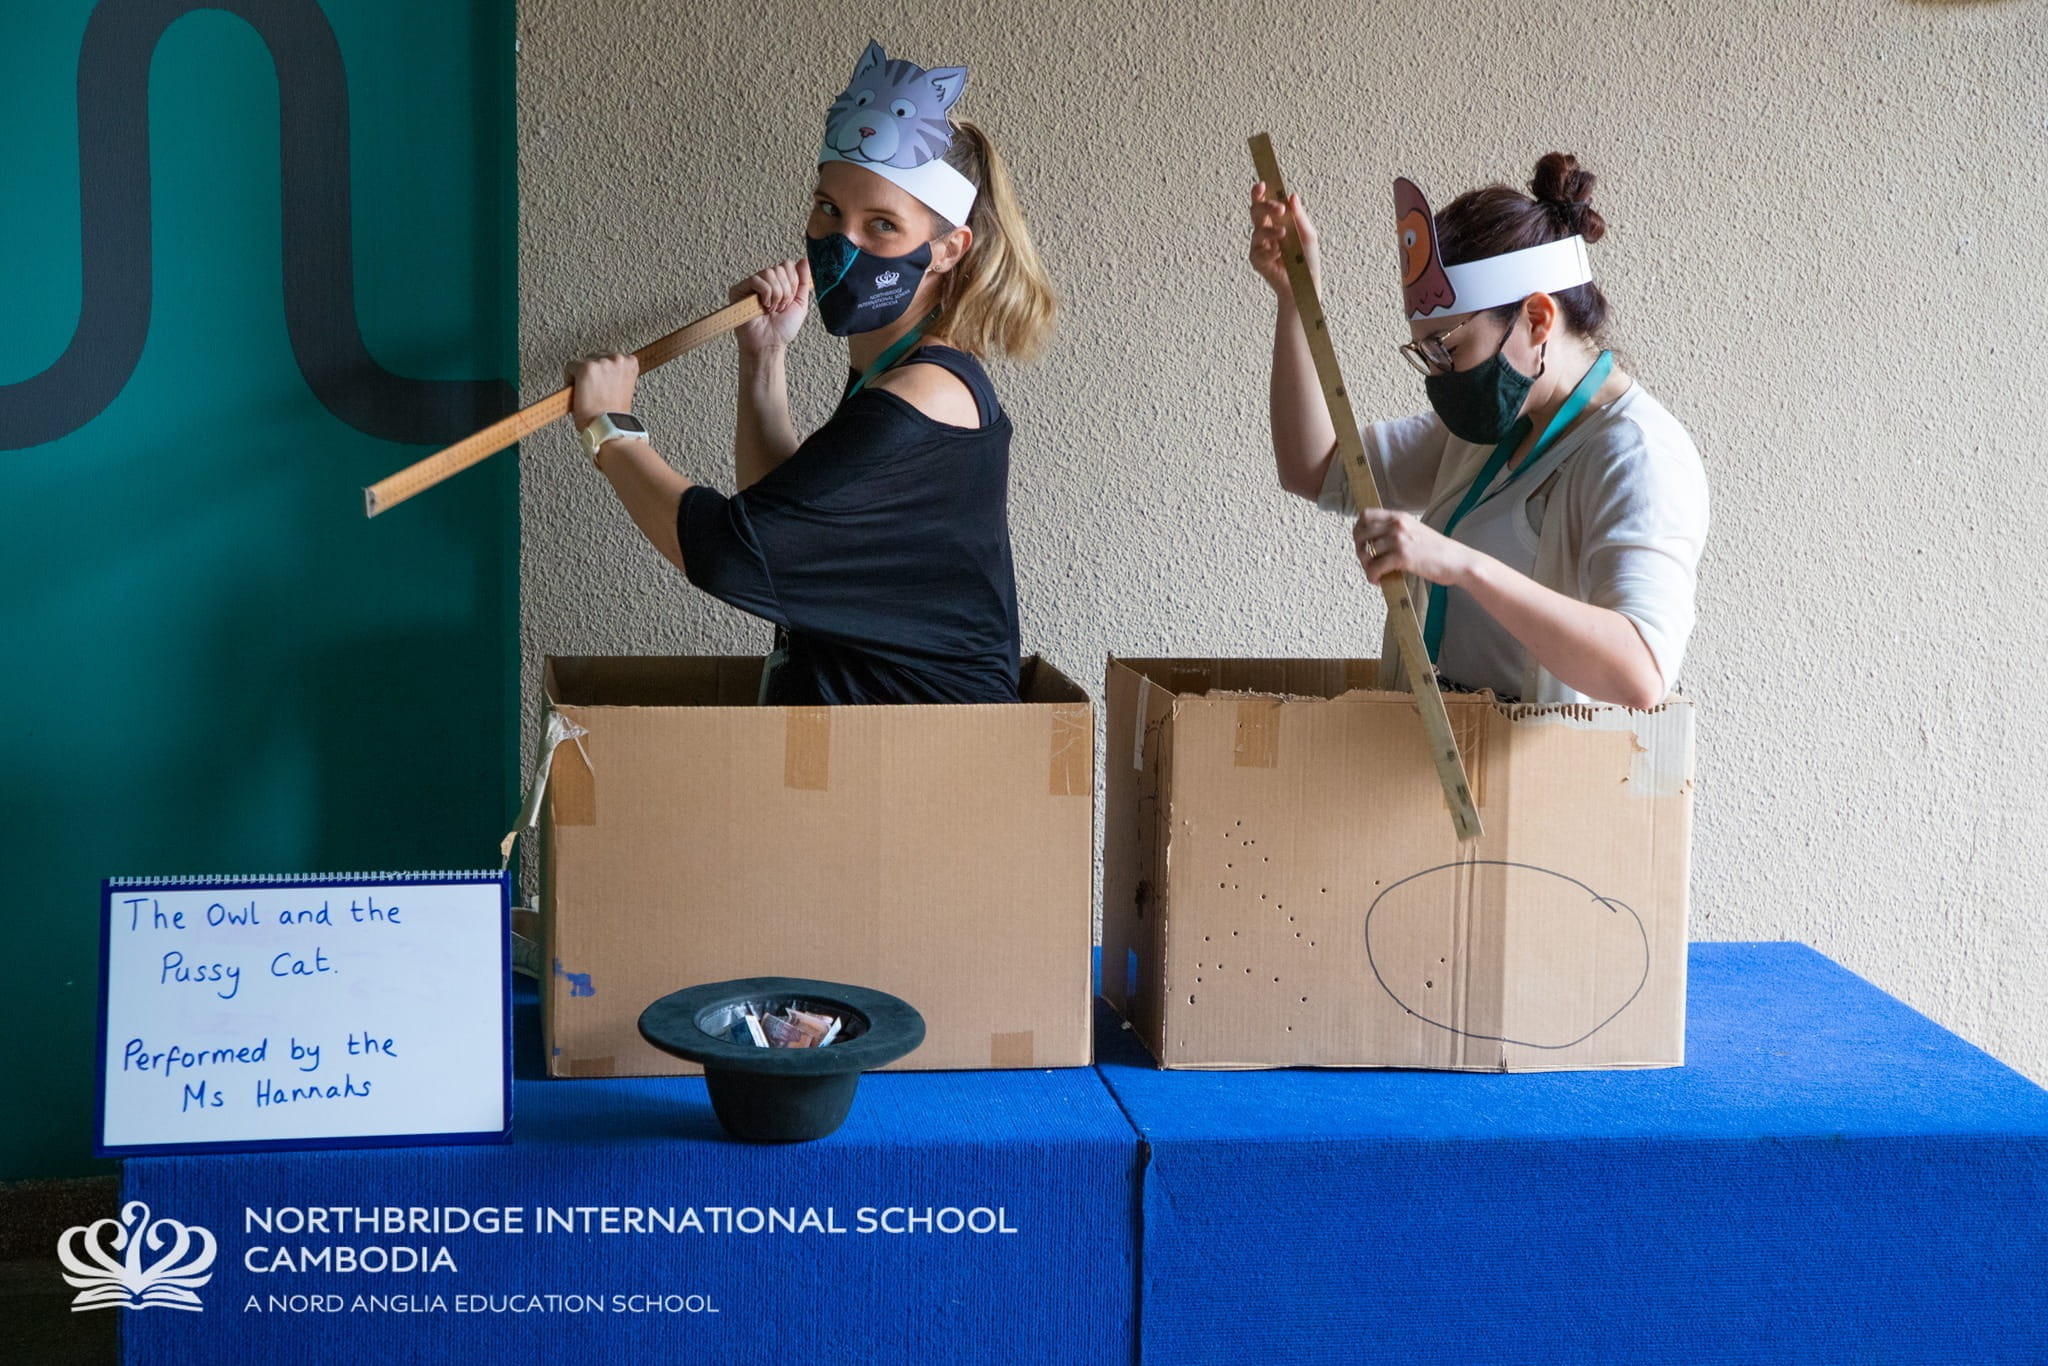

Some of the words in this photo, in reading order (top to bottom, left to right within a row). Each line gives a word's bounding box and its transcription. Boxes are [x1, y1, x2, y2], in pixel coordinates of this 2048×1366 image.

[123, 898, 186, 931] The
[207, 901, 260, 927] Owl
[279, 901, 332, 926] and
[350, 897, 401, 924] the
[161, 951, 240, 999] Pussy
[271, 947, 339, 977] Cat.
[124, 1038, 267, 1077] Performed
[291, 1037, 320, 1071] by
[348, 1031, 399, 1058] the
[183, 1080, 225, 1112] Ms
[257, 1074, 371, 1108] Hannahs
